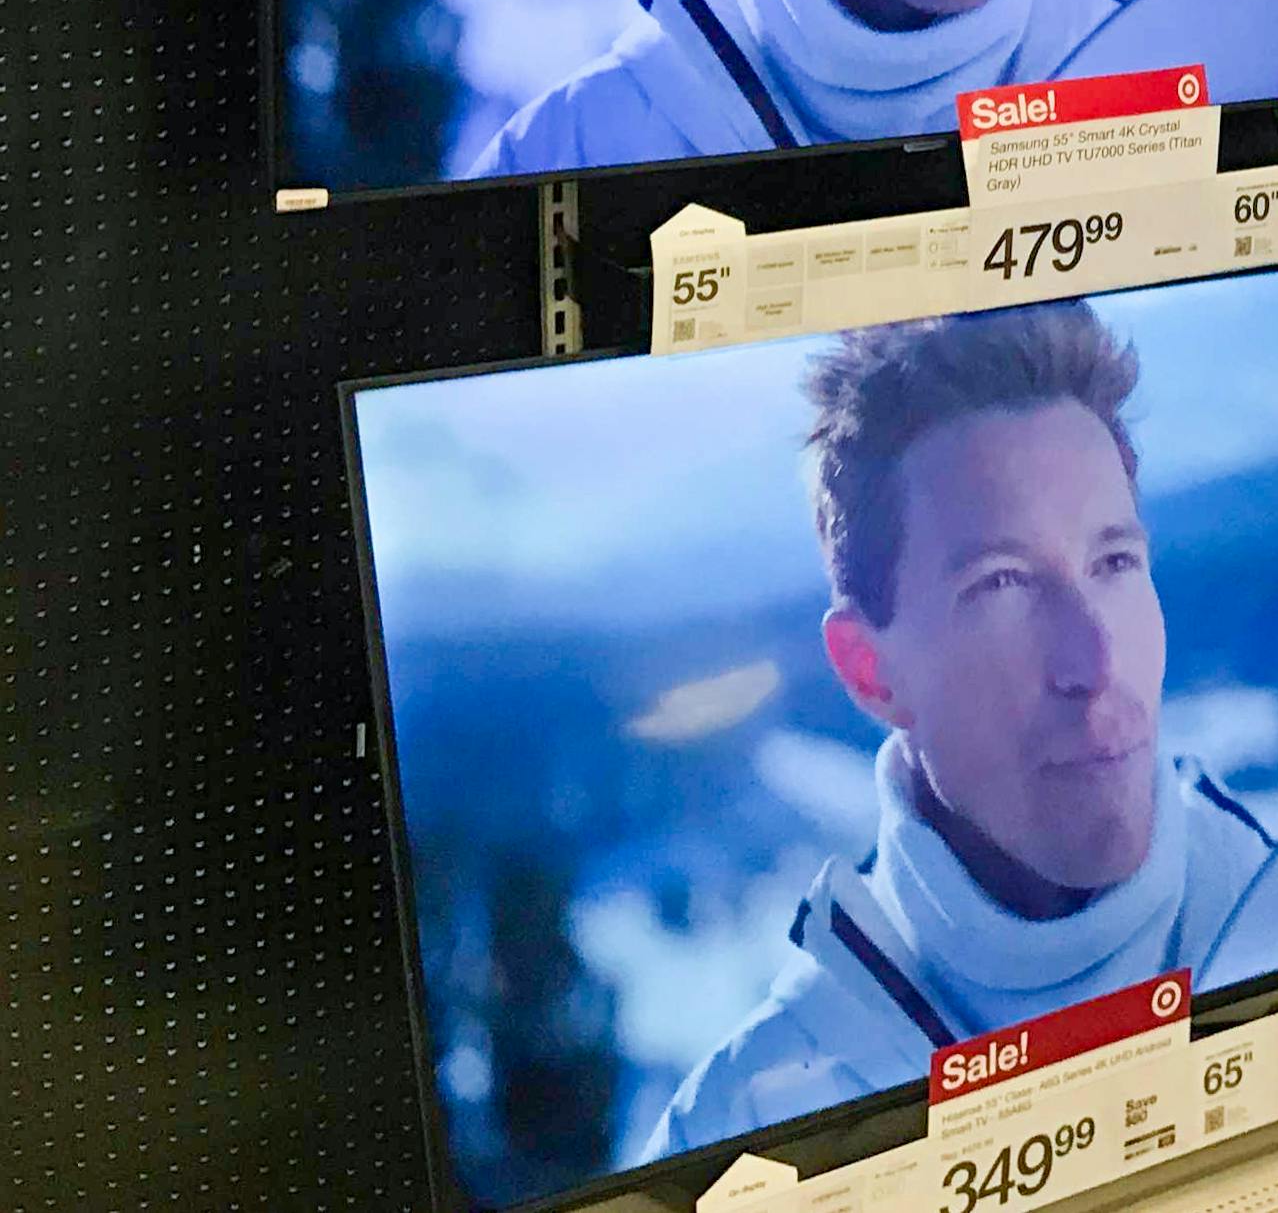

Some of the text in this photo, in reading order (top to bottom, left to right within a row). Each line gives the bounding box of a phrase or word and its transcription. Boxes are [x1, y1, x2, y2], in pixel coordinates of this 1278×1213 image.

[971, 90, 1057, 129] Sale!
[988, 136, 1201, 173] HDR UHD TV TU7000 Series (Titan
[991, 139, 1049, 155] Samsung
[1078, 130, 1115, 143] Smart
[1119, 126, 1135, 138] 4K
[1139, 120, 1181, 137] Crystal
[987, 175, 1021, 192] Gray)
[1234, 191, 1278, 224] 60"
[673, 266, 730, 305] 55"
[942, 1032, 1029, 1091] Sale!
[1204, 1051, 1253, 1096] 65"
[1126, 1094, 1158, 1111] Save
